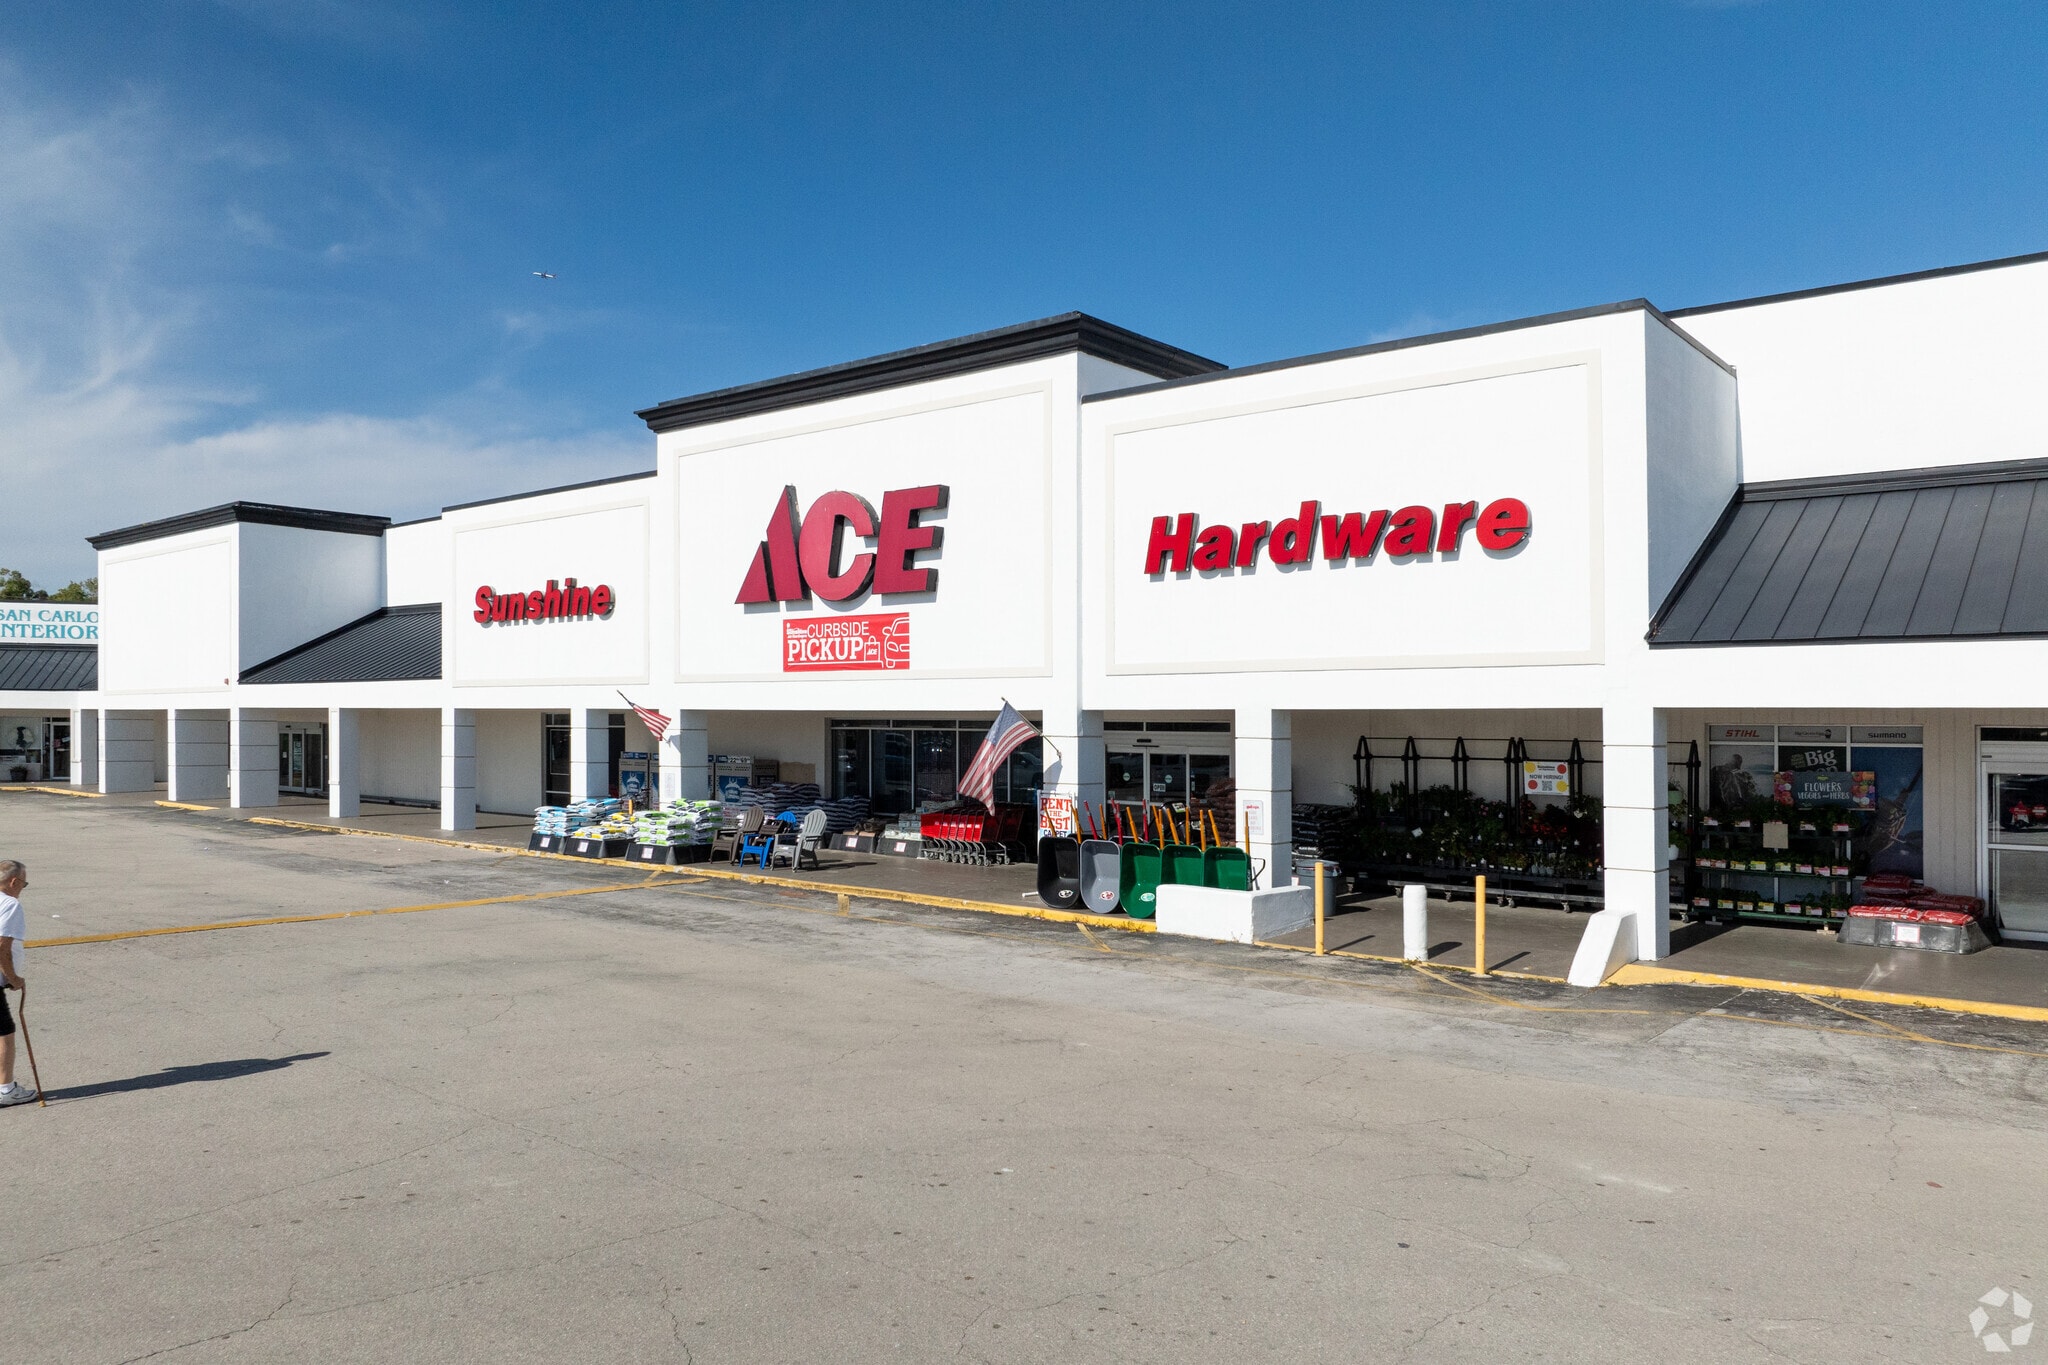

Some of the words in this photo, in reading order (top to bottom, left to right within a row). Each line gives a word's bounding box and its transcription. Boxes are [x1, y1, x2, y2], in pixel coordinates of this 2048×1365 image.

[1144, 497, 1532, 575] Hardware
[735, 484, 949, 604] ACE
[473, 577, 614, 623] Sunshine
[0, 609, 31, 622] SAN
[38, 610, 98, 623] CARLO
[807, 621, 870, 638] CURBSIDE
[787, 637, 864, 662] PICKUP
[867, 648, 878, 656] ACE
[1725, 729, 1760, 738] STIHL
[1804, 749, 1837, 767] Big
[1804, 782, 1842, 792] FLOWERS
[1830, 792, 1850, 800] HERBS
[1040, 797, 1072, 812] RENT
[1049, 810, 1062, 818] THE
[1043, 829, 1068, 837] CAPET
